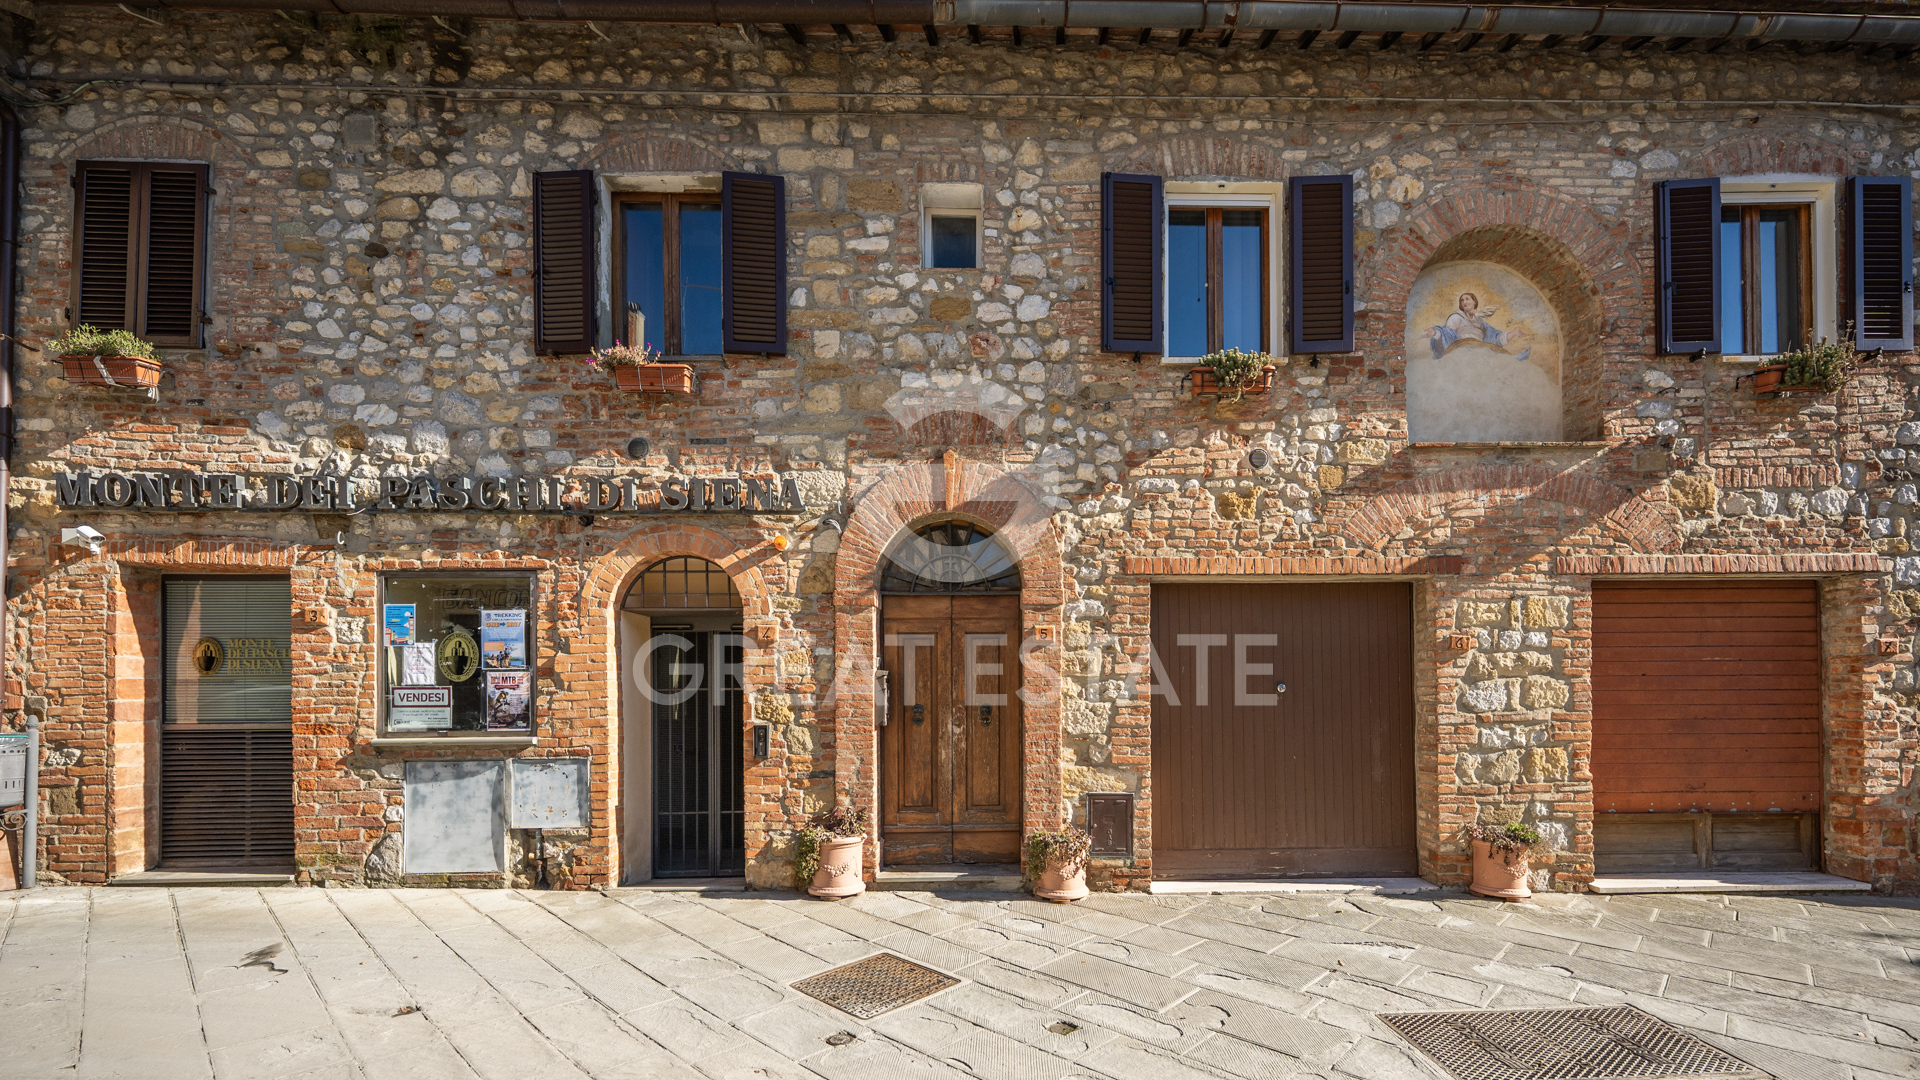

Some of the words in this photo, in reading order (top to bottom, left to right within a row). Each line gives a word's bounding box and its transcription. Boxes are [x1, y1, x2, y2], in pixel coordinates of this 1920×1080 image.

[52, 473, 246, 508] MONTE
[267, 475, 356, 509] DEI
[377, 476, 565, 510] PASCHI
[587, 477, 637, 510] DI
[660, 477, 807, 510] SIENA
[310, 610, 317, 622] 3
[1040, 628, 1048, 640] 5
[227, 639, 275, 648] MONTE
[1455, 636, 1464, 649] 6
[1884, 641, 1893, 652] 7
[227, 649, 249, 658] DEI
[227, 659, 241, 669] DI
[243, 659, 283, 669] SIENA
[501, 676, 517, 684] MTB
[398, 692, 445, 702] VENDESI
